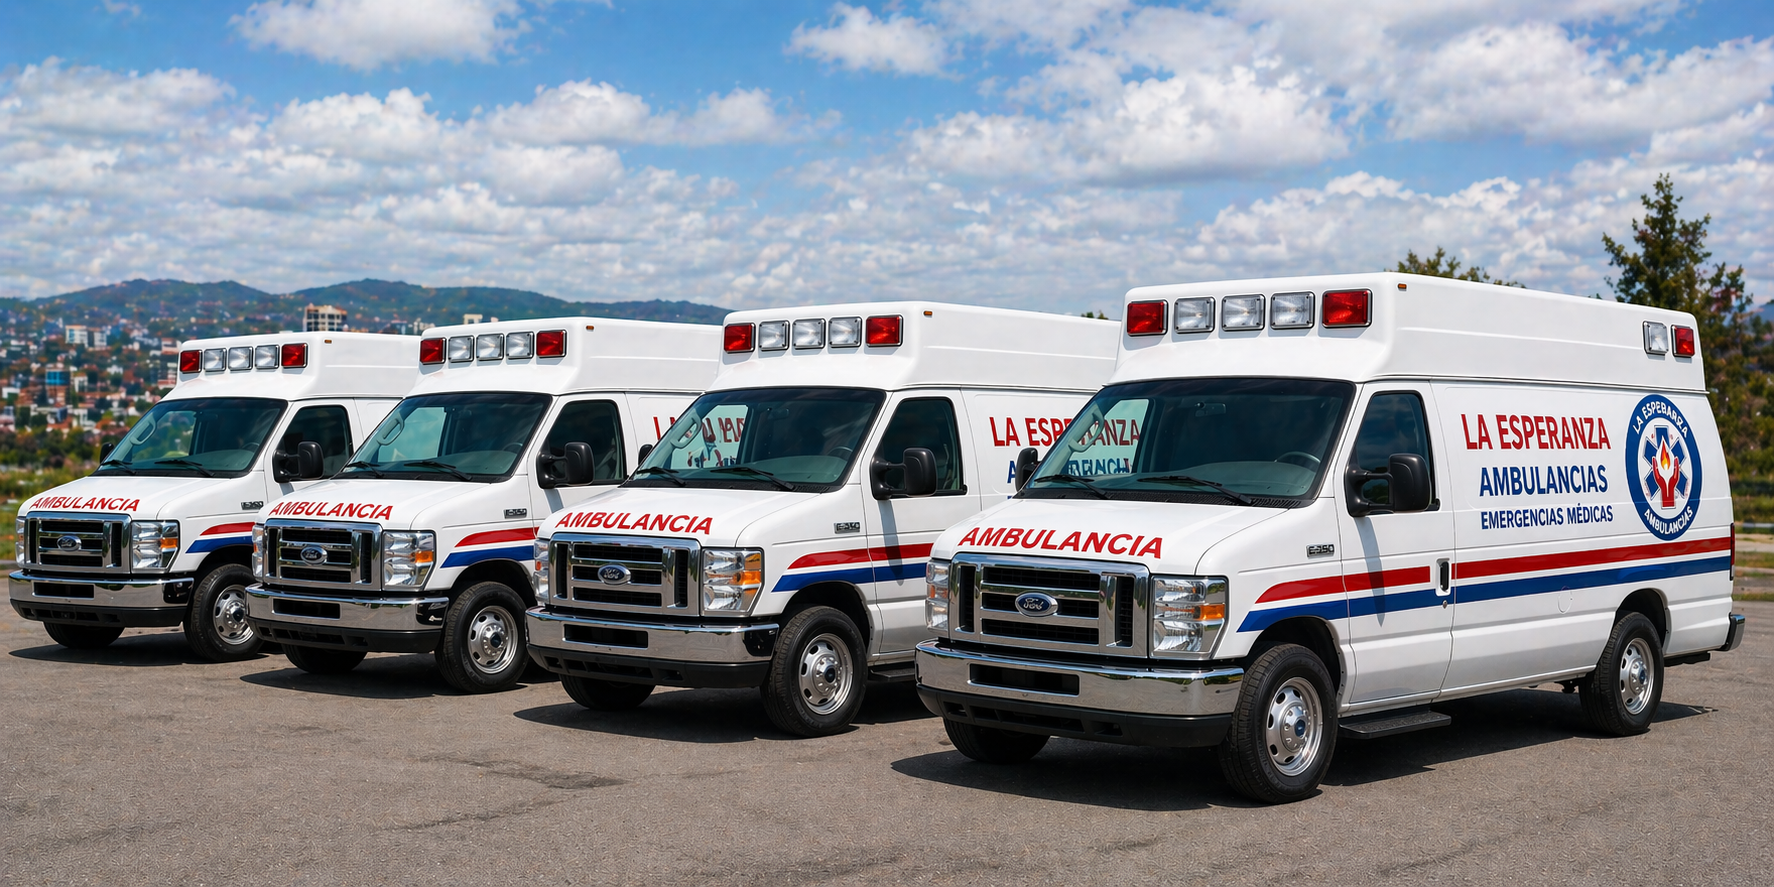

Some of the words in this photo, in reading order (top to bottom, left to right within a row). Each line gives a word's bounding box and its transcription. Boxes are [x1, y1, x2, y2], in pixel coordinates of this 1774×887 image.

[989, 416, 1021, 447] LA
[1461, 413, 1494, 450] LA
[1495, 414, 1612, 450] ESPERANZA
[1633, 415, 1644, 435] LA
[1479, 464, 1608, 497] AMBULANCIAS
[29, 496, 140, 512] AMBULANCIA
[268, 501, 394, 521] AMBULANCIA
[1481, 507, 1564, 530] EMERGENCIAS
[1567, 502, 1614, 525] MÉDICAS
[555, 511, 713, 535] AMBULANCIA
[957, 526, 1163, 559] AMBULANCIA
